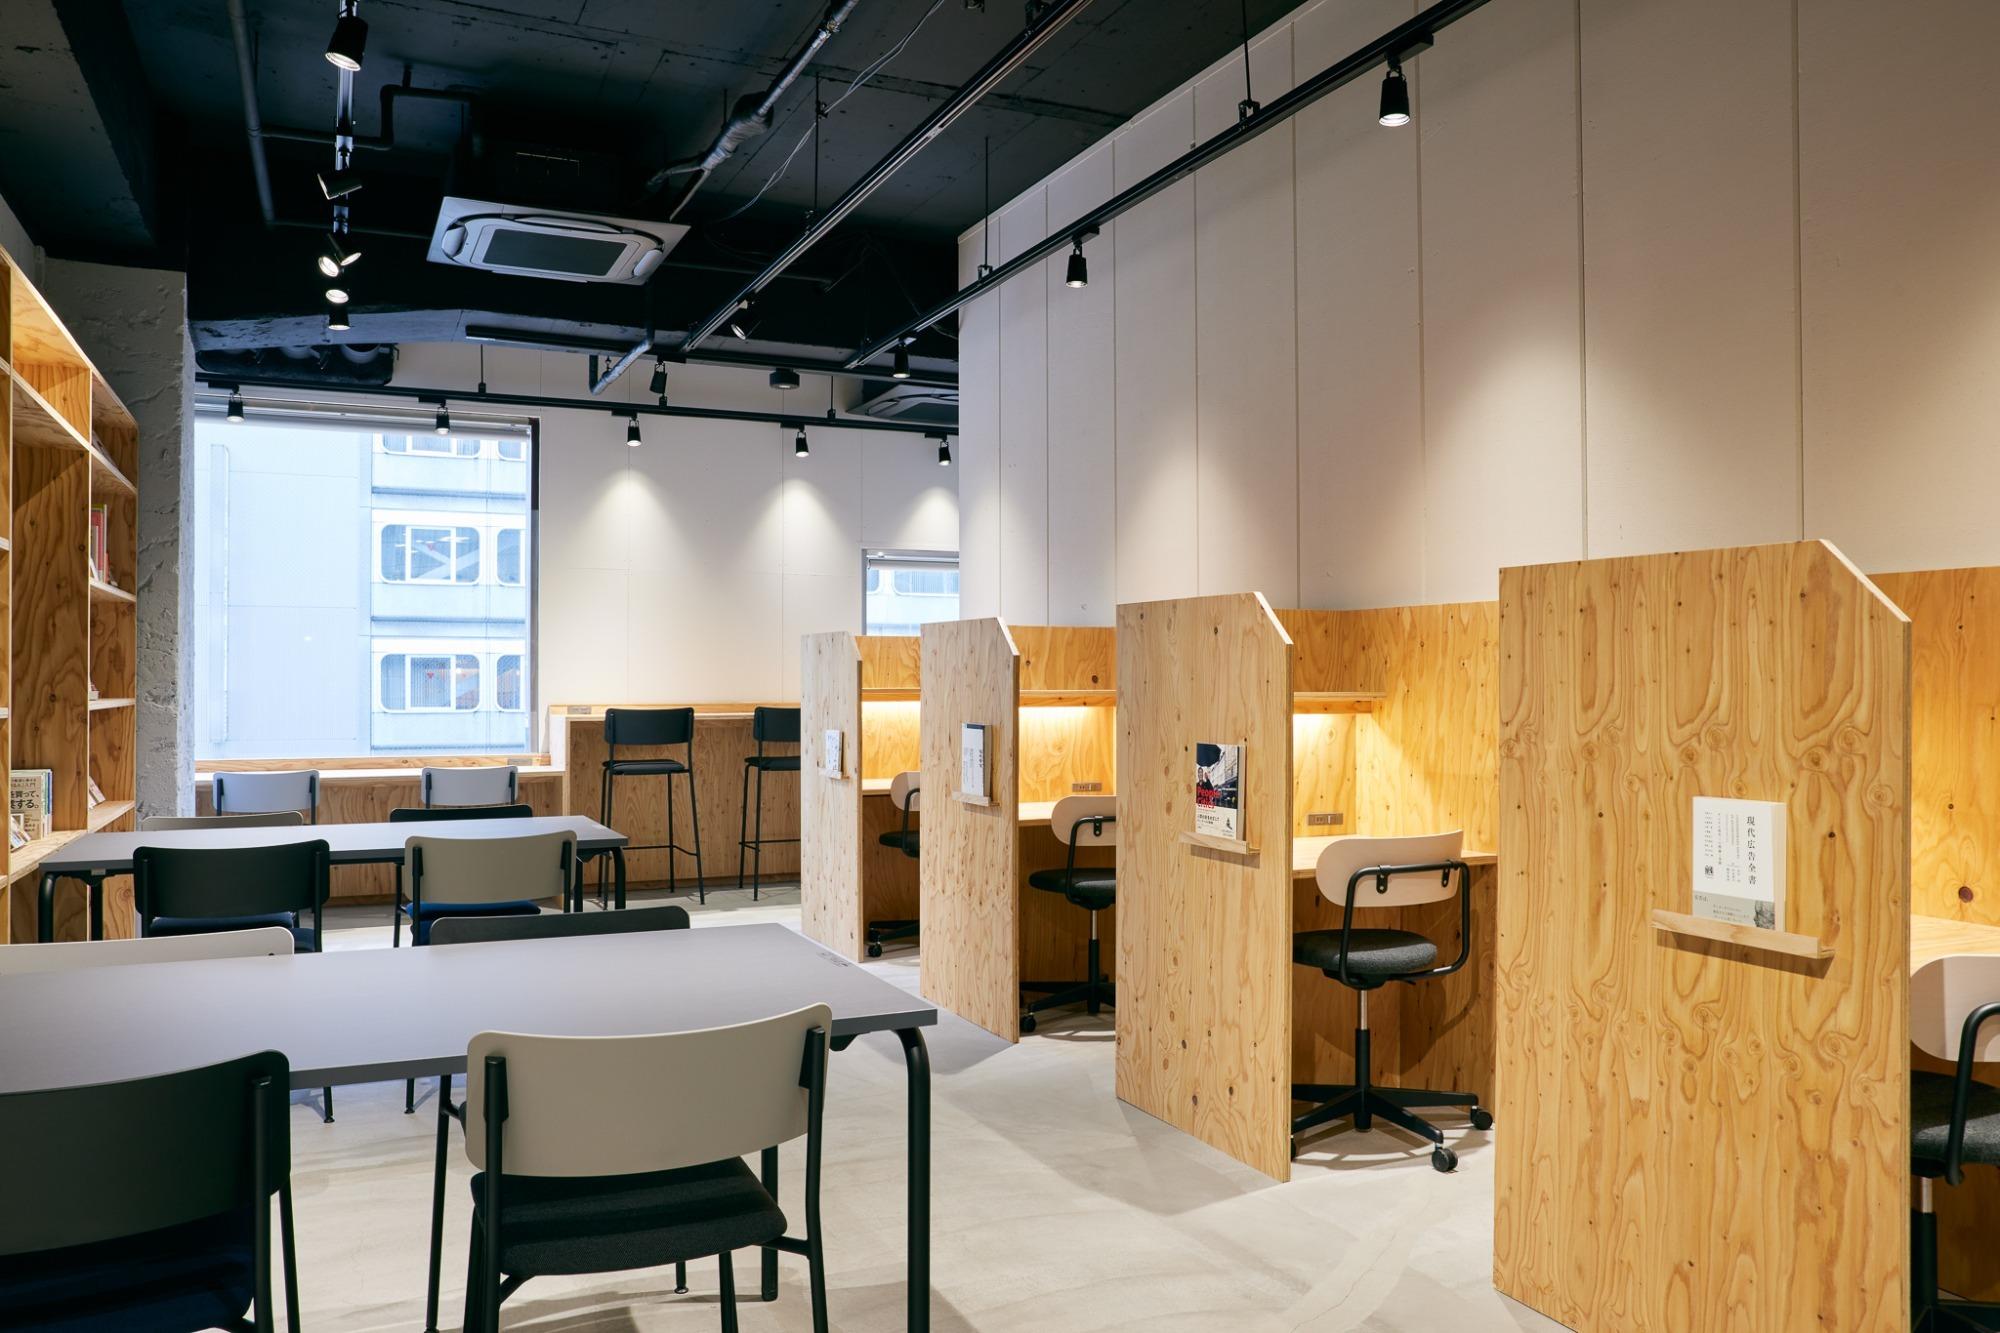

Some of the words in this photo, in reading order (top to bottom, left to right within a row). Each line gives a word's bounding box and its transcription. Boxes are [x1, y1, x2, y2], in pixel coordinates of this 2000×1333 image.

[1746, 816, 1757, 885] 現代広告全書
